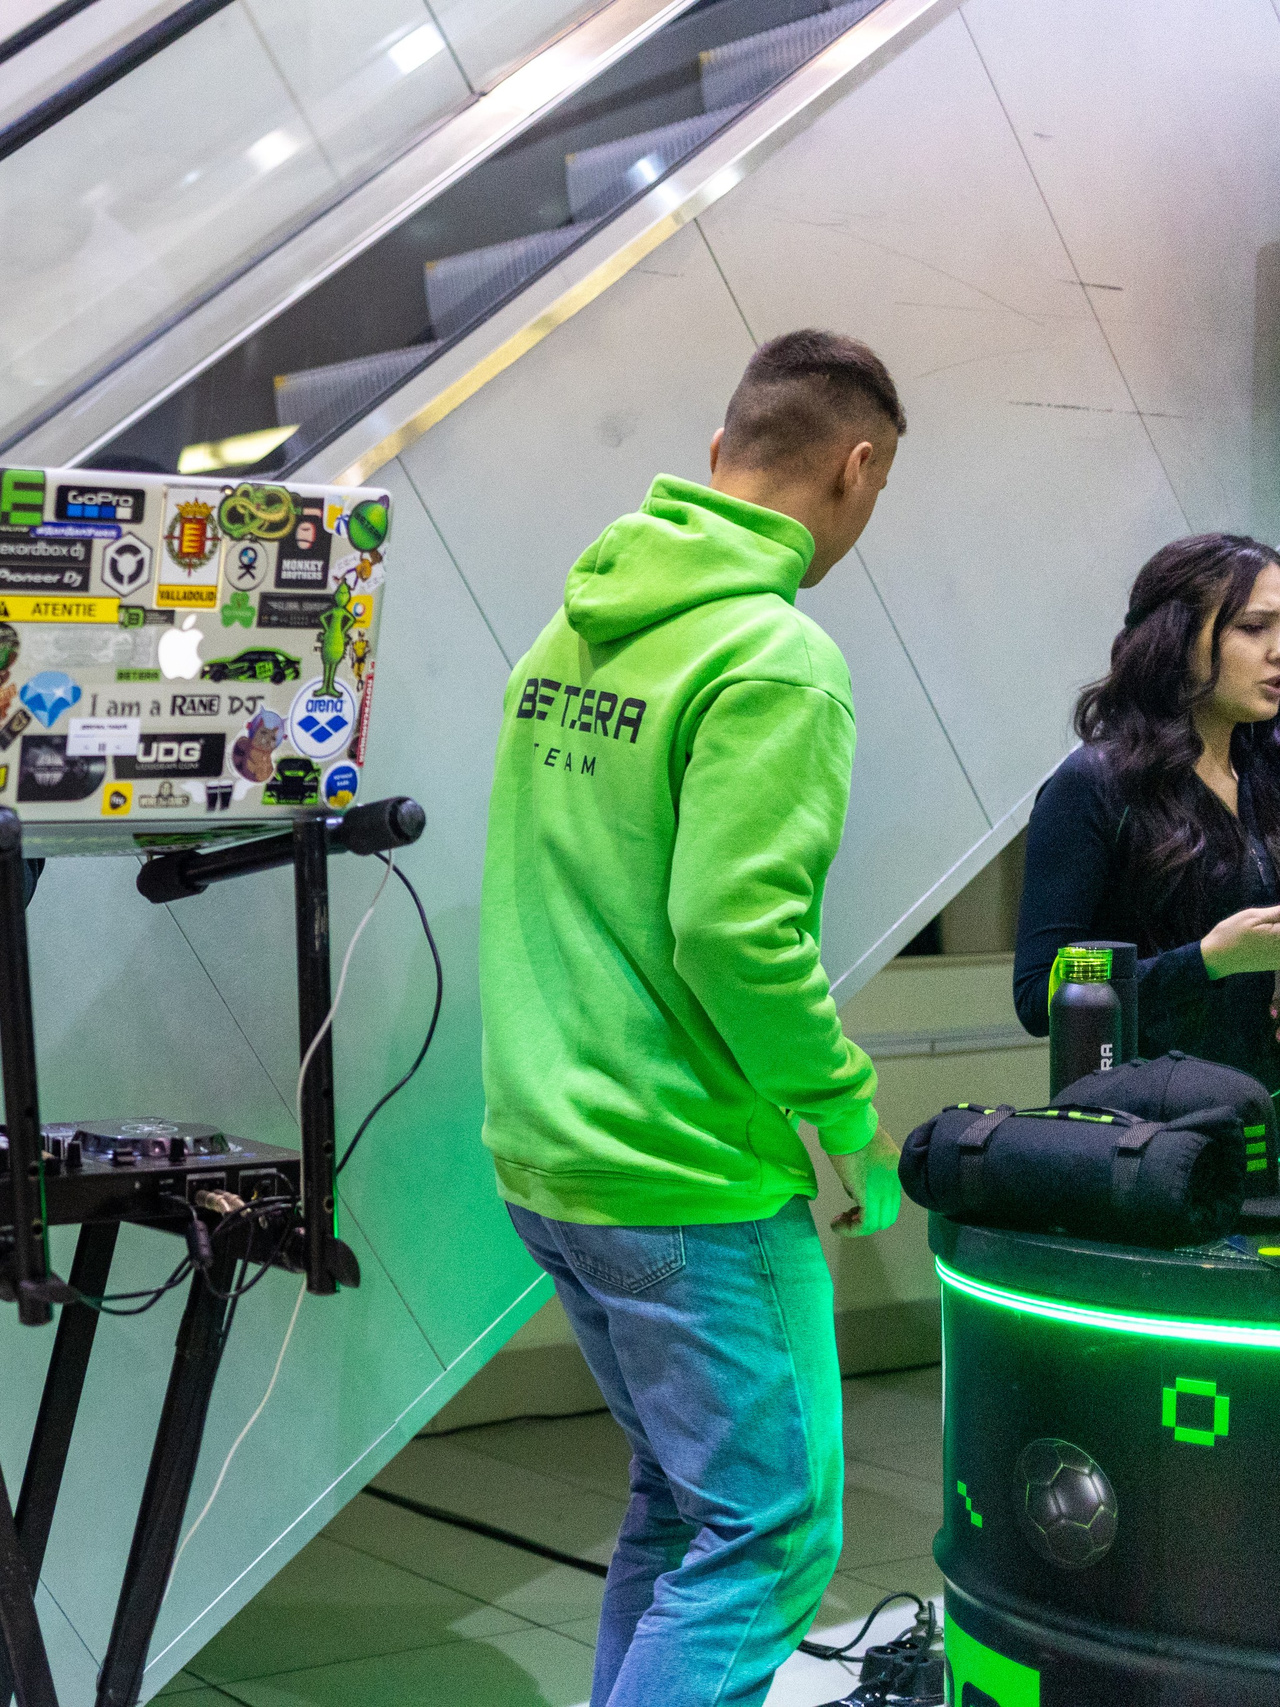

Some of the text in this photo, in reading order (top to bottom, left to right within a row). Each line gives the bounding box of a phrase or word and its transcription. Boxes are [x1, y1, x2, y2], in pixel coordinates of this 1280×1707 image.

[67, 491, 133, 507] GoPro
[69, 543, 86, 561] dj
[282, 559, 324, 571] MONKEY
[281, 570, 323, 580] BROTHERS
[159, 590, 216, 602] VALLADOLID
[89, 694, 265, 716] I am a RANE DJ
[305, 698, 343, 713] arena
[136, 741, 201, 763] UDG
